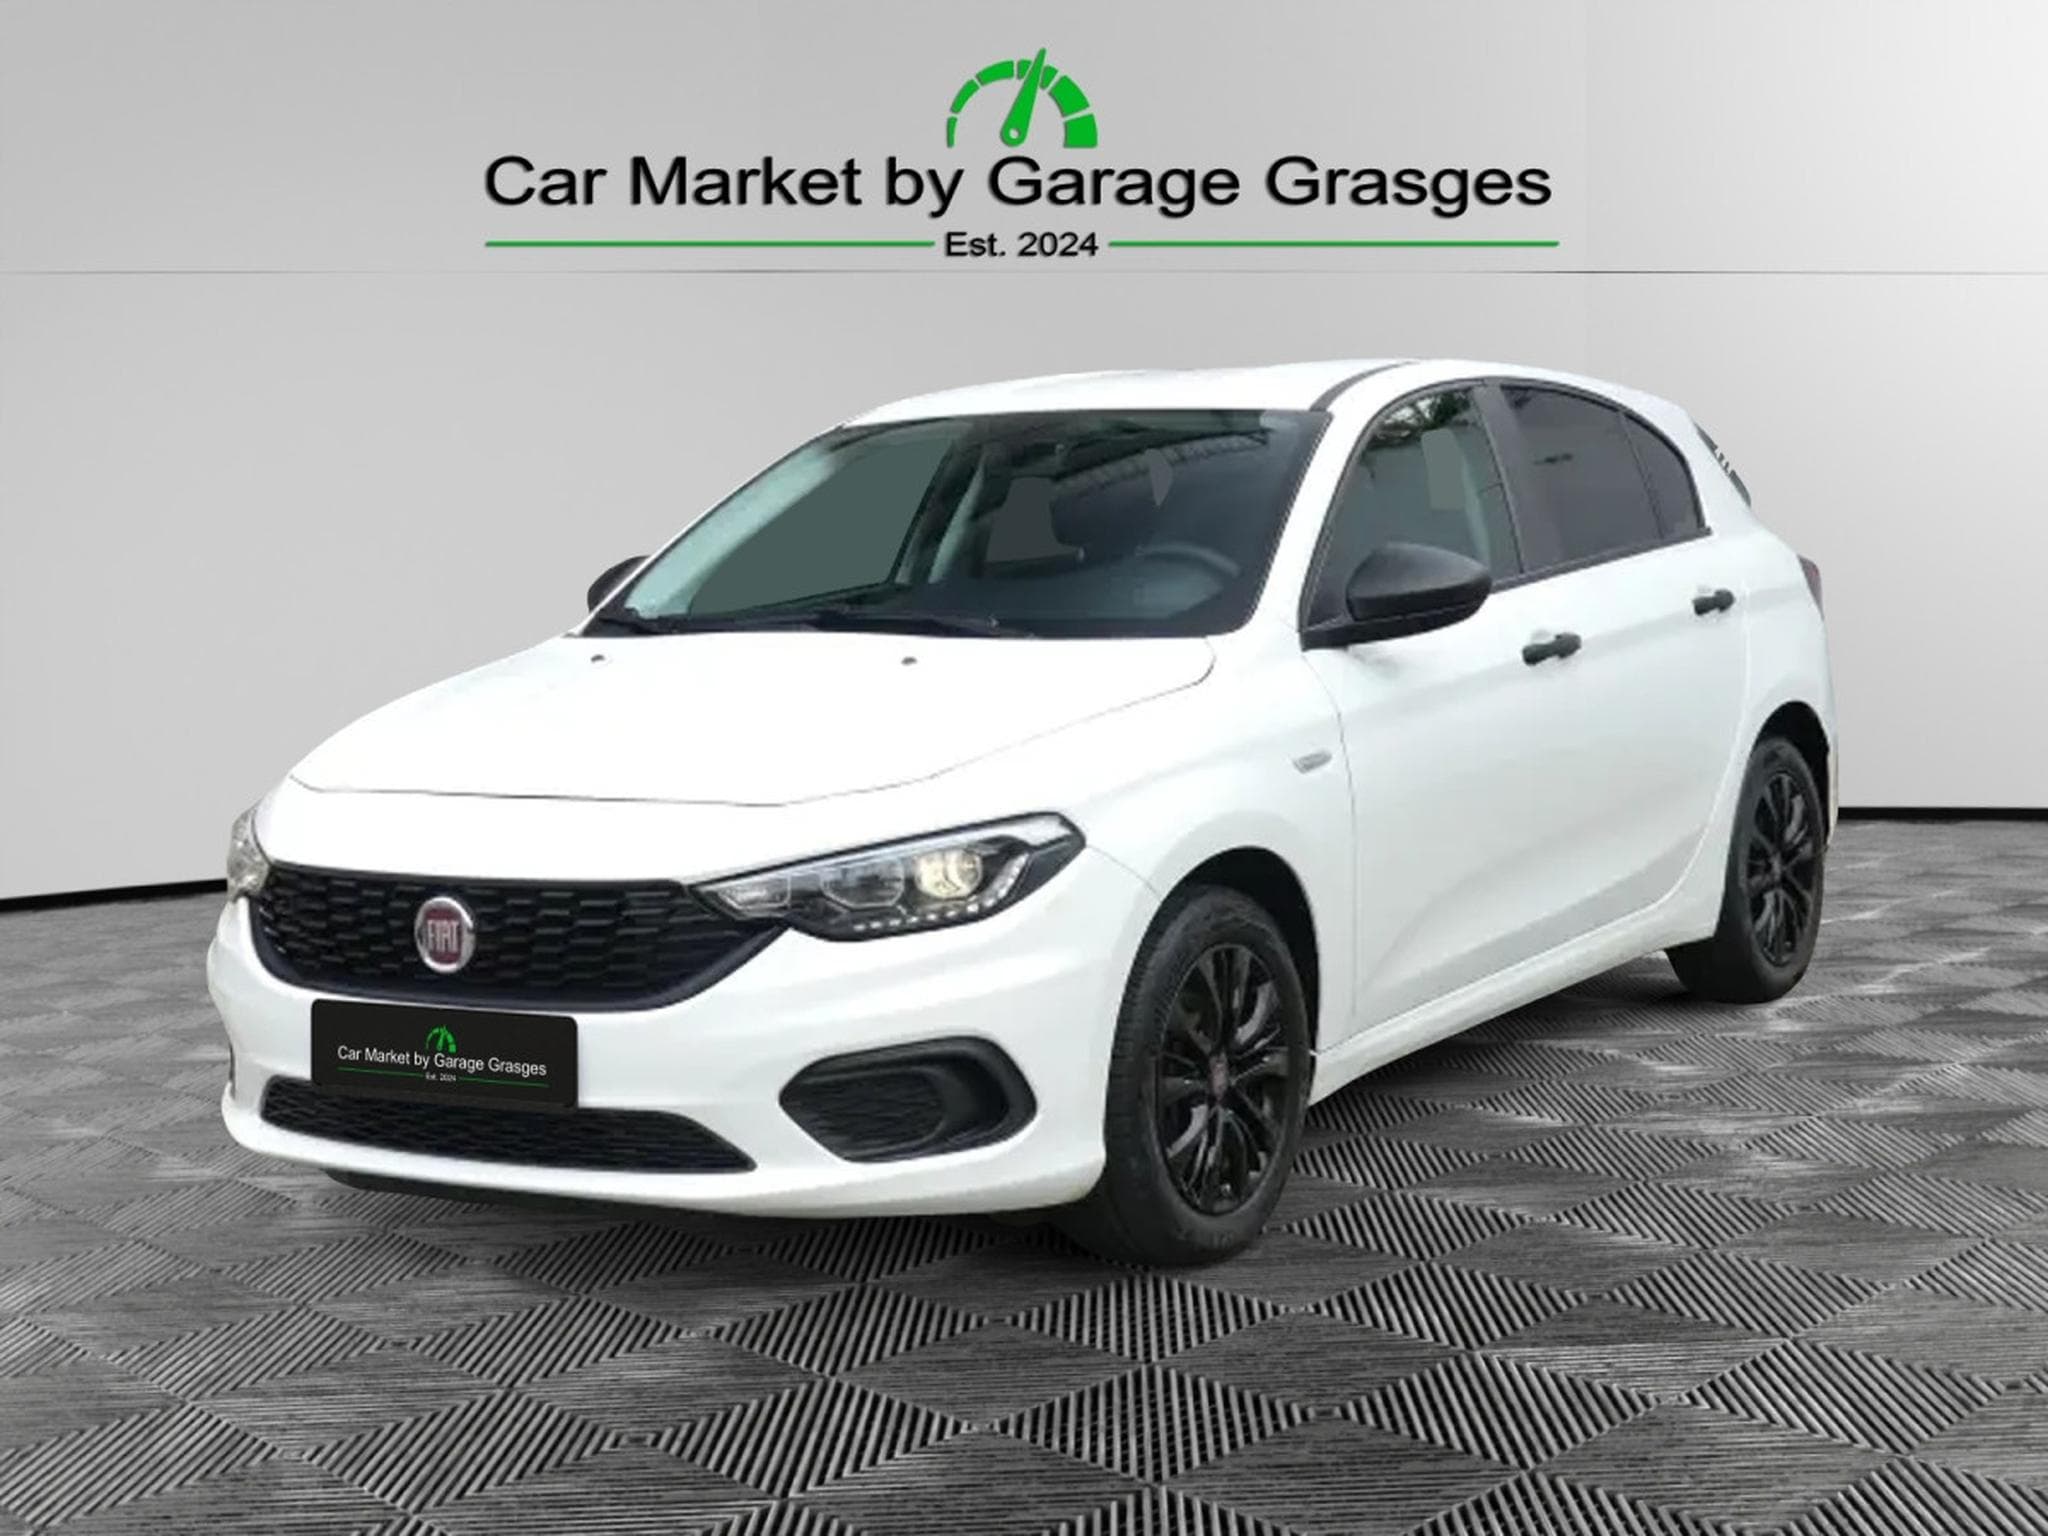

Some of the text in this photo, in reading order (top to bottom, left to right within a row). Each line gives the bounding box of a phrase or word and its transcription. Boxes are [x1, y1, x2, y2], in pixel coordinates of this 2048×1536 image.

[427, 919, 460, 952] FIAT
[337, 1045, 547, 1078] Car Market by Garage Grasges
